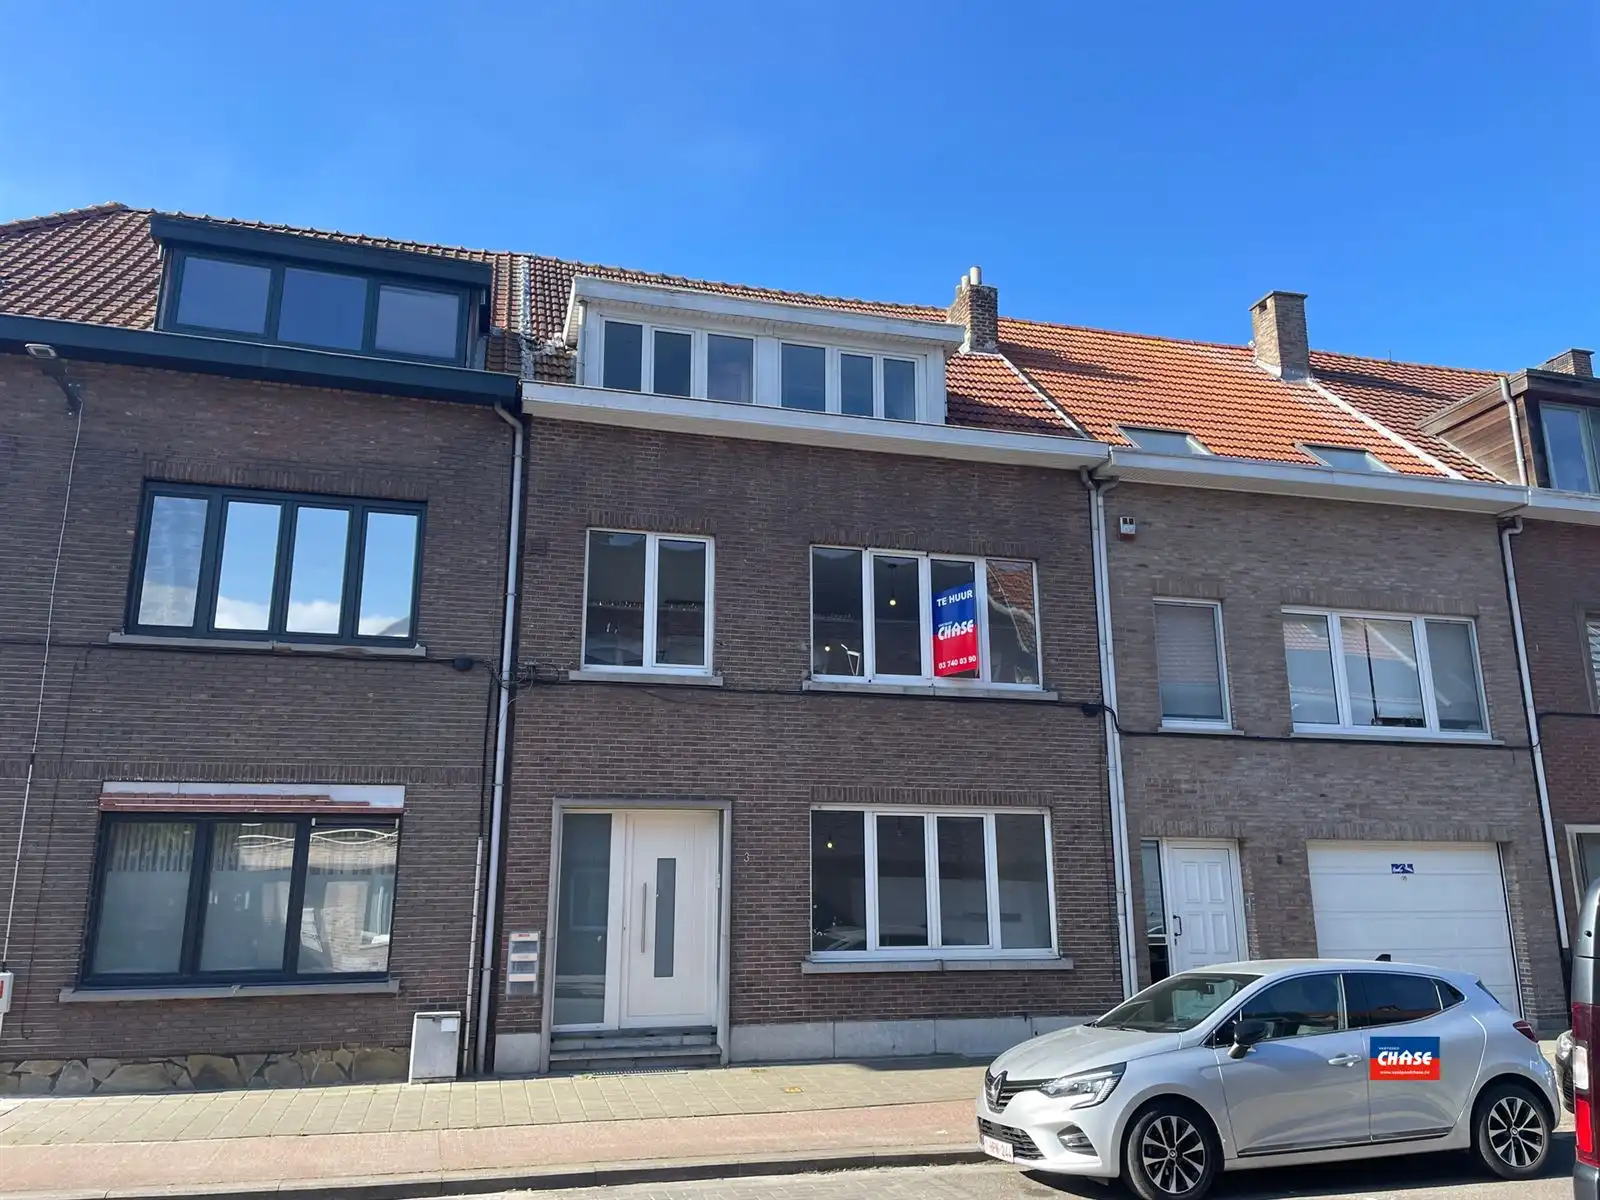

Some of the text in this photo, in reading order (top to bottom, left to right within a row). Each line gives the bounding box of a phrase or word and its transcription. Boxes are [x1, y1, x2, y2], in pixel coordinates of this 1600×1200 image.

[936, 590, 973, 607] TE HUUR
[938, 619, 974, 641] CHASE
[744, 851, 750, 863] 3
[1377, 1050, 1432, 1066] CHASE
